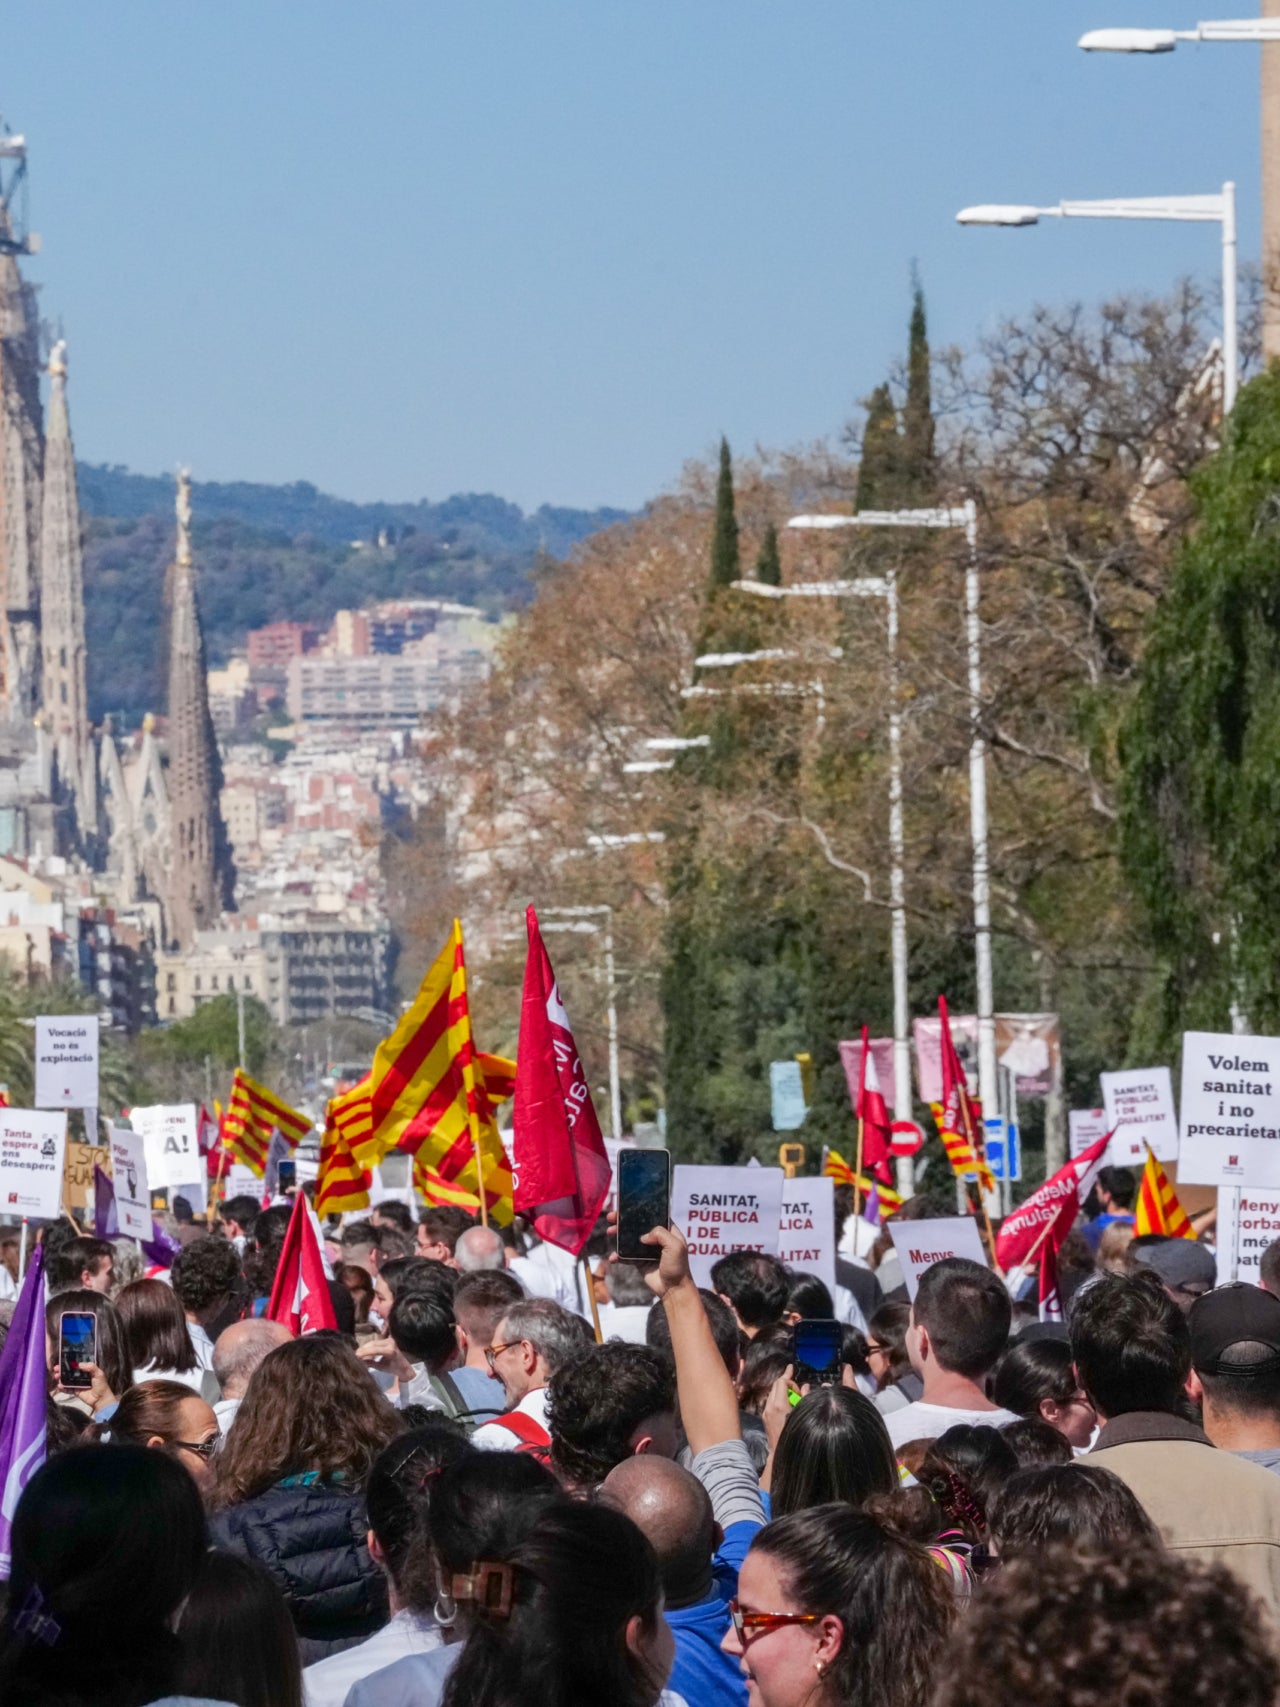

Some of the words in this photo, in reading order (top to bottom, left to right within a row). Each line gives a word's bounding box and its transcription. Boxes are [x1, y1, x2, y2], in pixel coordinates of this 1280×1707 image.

[48, 1027, 87, 1037] Vocació
[41, 1053, 94, 1065] explotació
[1208, 1055, 1270, 1072] Volem
[1114, 1084, 1158, 1096] SANITAT,
[1203, 1079, 1272, 1096] sanitat
[1218, 1101, 1224, 1116] i
[1230, 1106, 1254, 1118] no
[4, 1128, 32, 1139] Tanta
[2, 1140, 38, 1150] espera
[2, 1150, 20, 1158] ens
[1, 1159, 56, 1171] desespera
[689, 1193, 760, 1210] SANITAT,
[1233, 1198, 1280, 1215] Meny
[688, 1207, 759, 1223] PÚBLICA
[782, 1202, 813, 1216] TAT,
[779, 1218, 813, 1230] LICA
[687, 1226, 691, 1238] I
[697, 1226, 720, 1239] DE
[781, 1249, 821, 1262] LITAT
